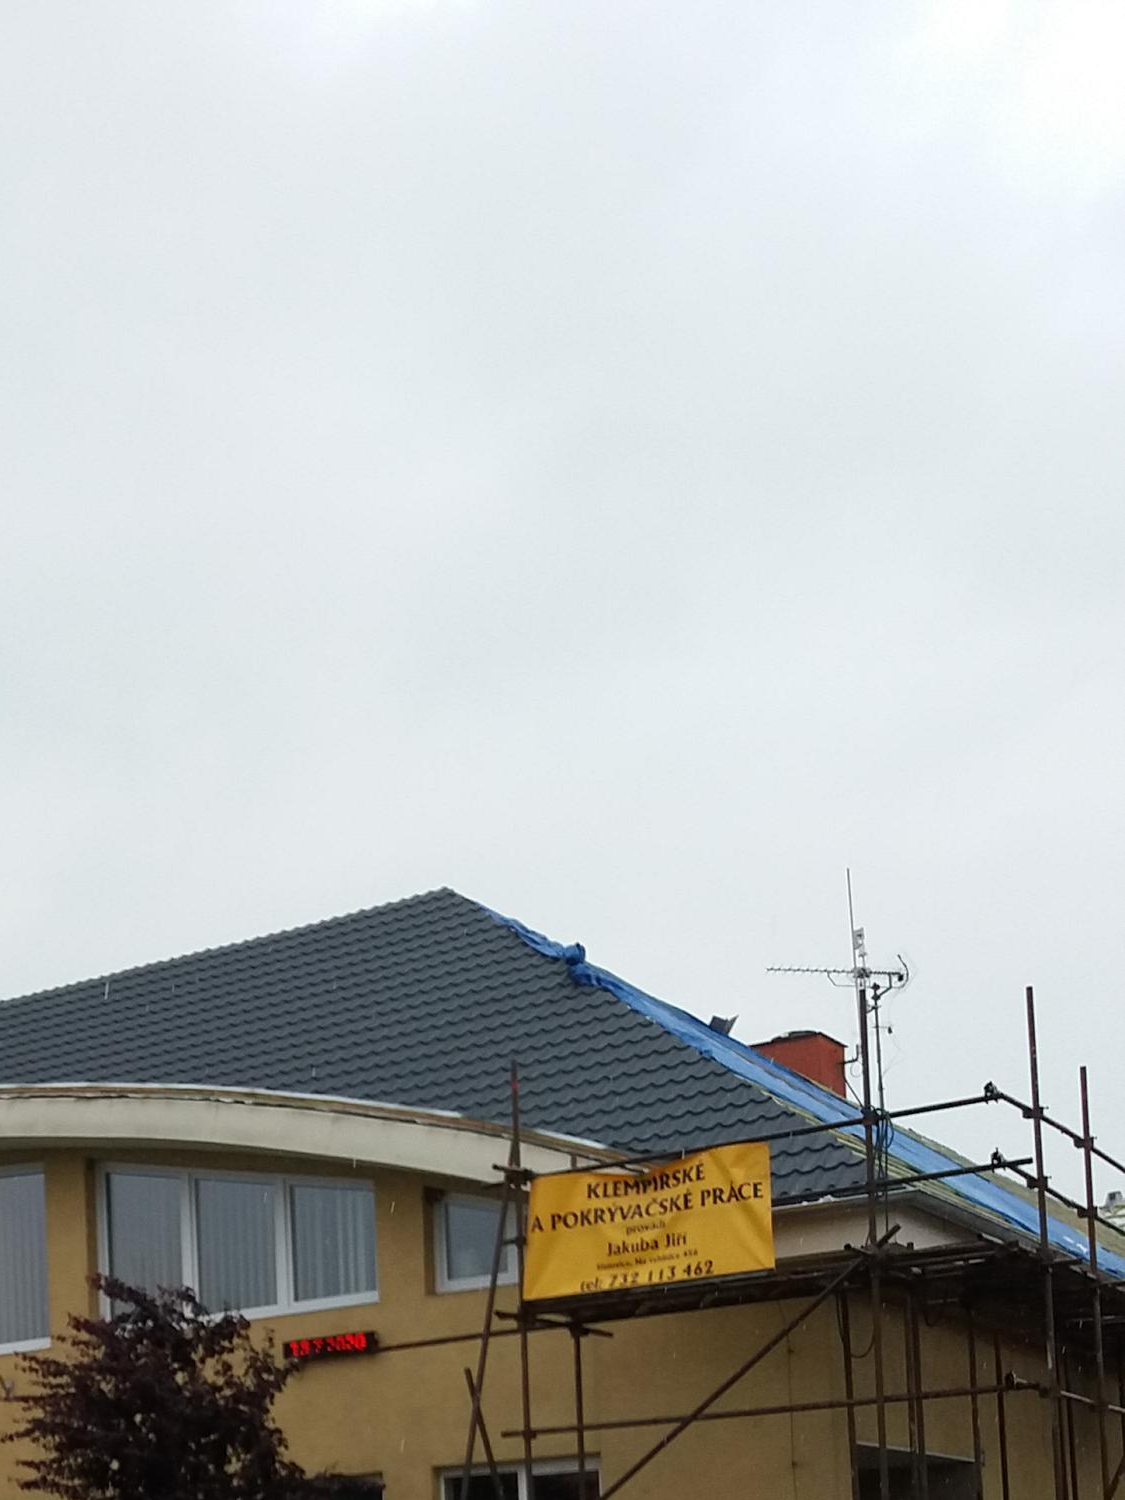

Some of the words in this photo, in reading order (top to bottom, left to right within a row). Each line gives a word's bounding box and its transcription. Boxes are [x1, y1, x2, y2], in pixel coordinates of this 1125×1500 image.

[530, 1214, 545, 1233] A
[549, 1187, 694, 1231] POKRÝVAČSKÉ
[700, 1179, 764, 1208] PRÁCE
[606, 1236, 659, 1257] Jakuba
[609, 1271, 640, 1289] 732
[647, 1264, 676, 1281] 113
[682, 1258, 714, 1277] 462
